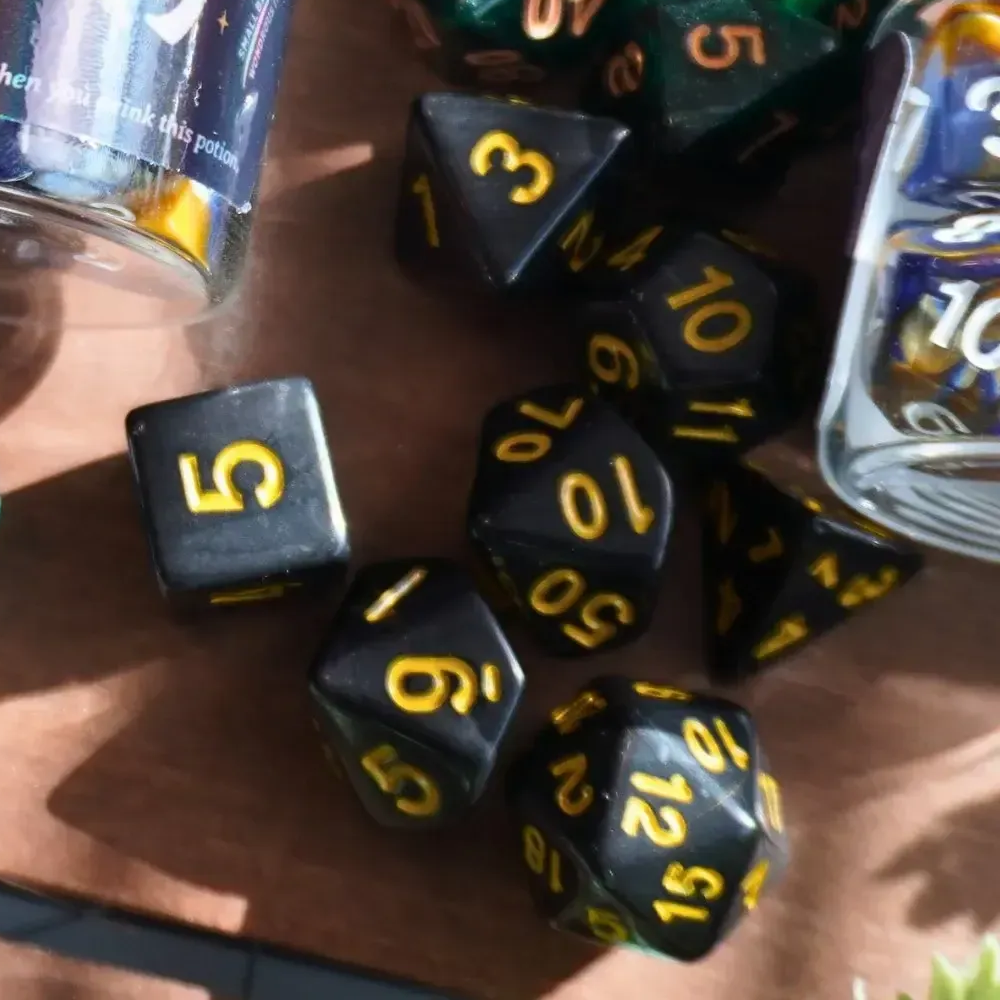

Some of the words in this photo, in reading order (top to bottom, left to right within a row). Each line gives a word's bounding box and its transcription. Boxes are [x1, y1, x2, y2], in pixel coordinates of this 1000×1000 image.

[686, 23, 767, 71] 5
[159, 112, 194, 144] this
[469, 129, 556, 206] 3
[667, 265, 752, 353] 10
[496, 396, 585, 463] 70
[672, 398, 756, 443] 11
[178, 440, 285, 513] 5
[559, 454, 656, 541] 10
[530, 567, 636, 649] 50
[361, 743, 442, 816] 5
[682, 716, 750, 774] 10
[549, 752, 594, 817] 2
[620, 771, 694, 849] 12
[653, 860, 726, 923] 15
